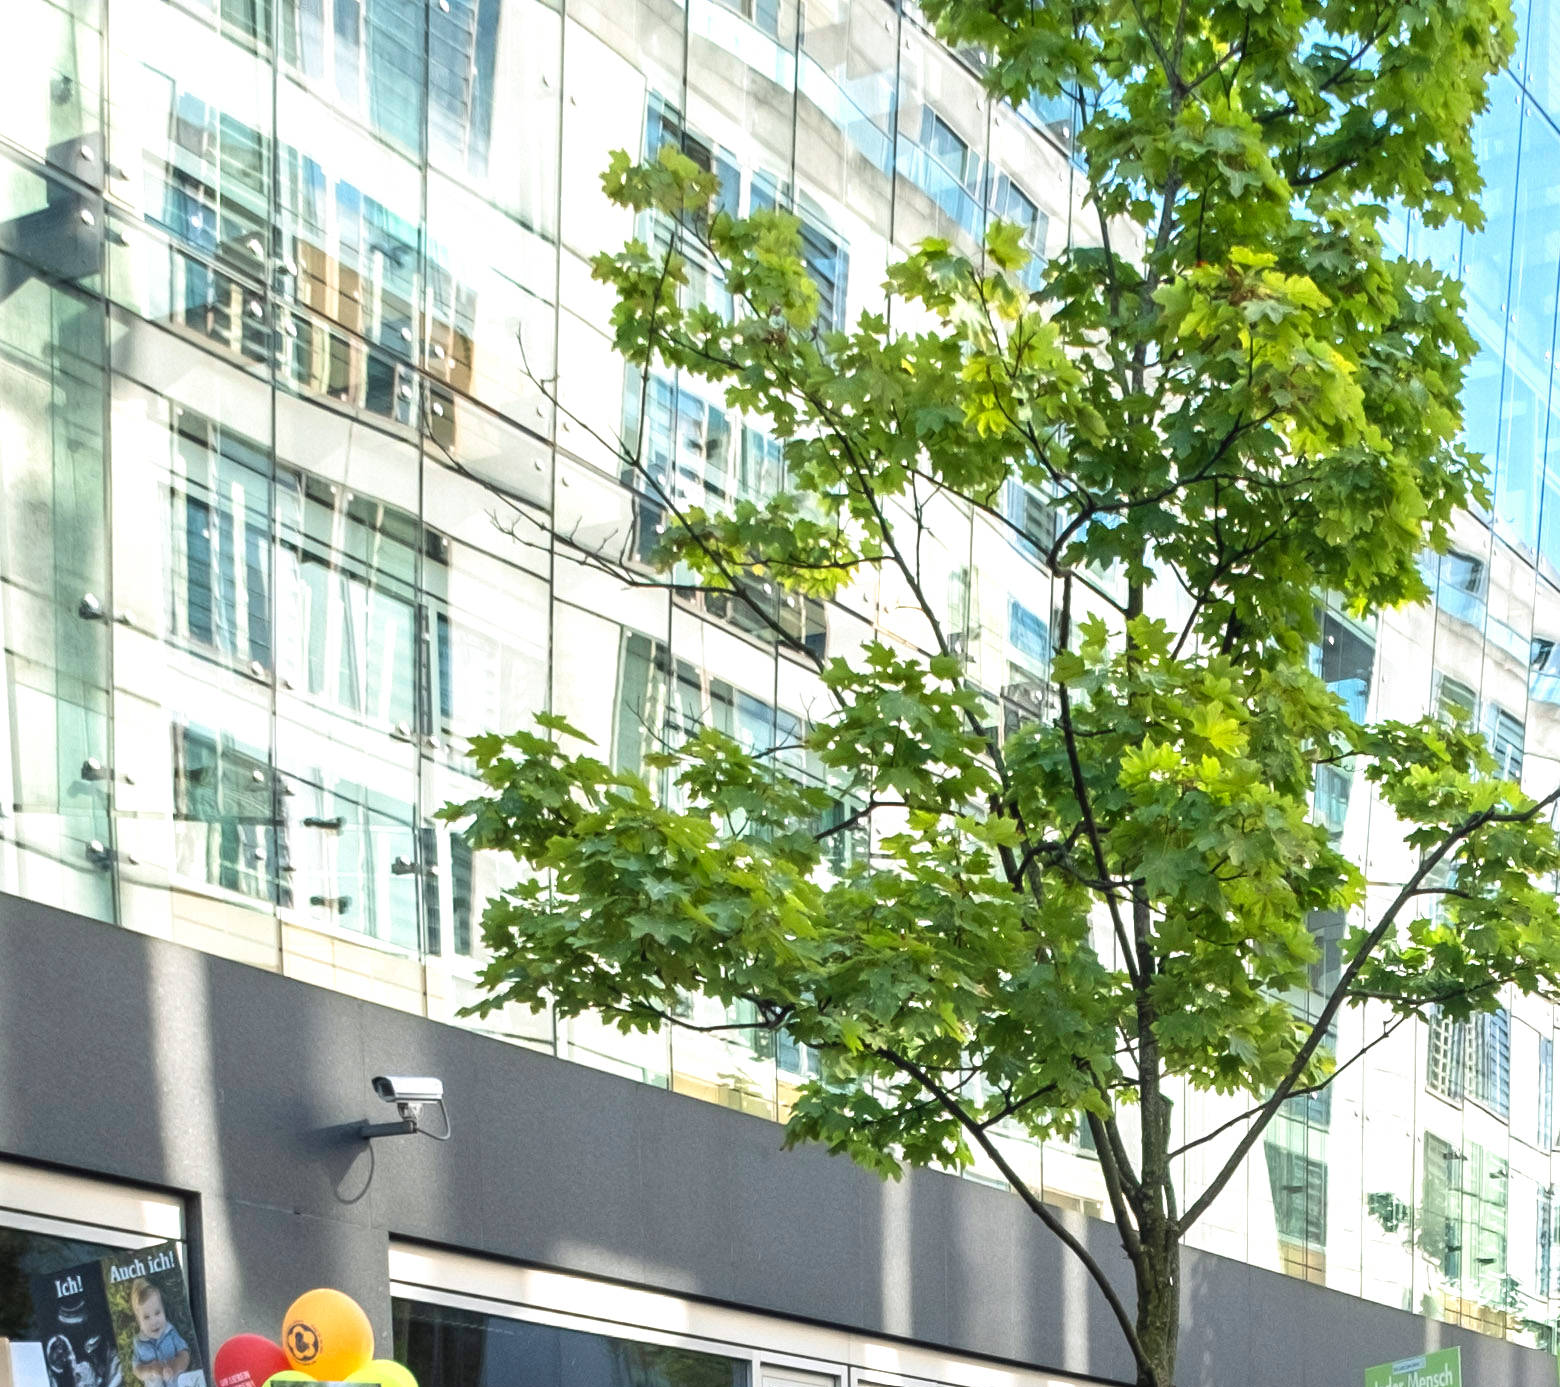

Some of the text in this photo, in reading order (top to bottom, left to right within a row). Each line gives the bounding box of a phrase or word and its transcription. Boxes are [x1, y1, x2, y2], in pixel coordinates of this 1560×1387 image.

[54, 1251, 175, 1298] Ich! Auch ich!
